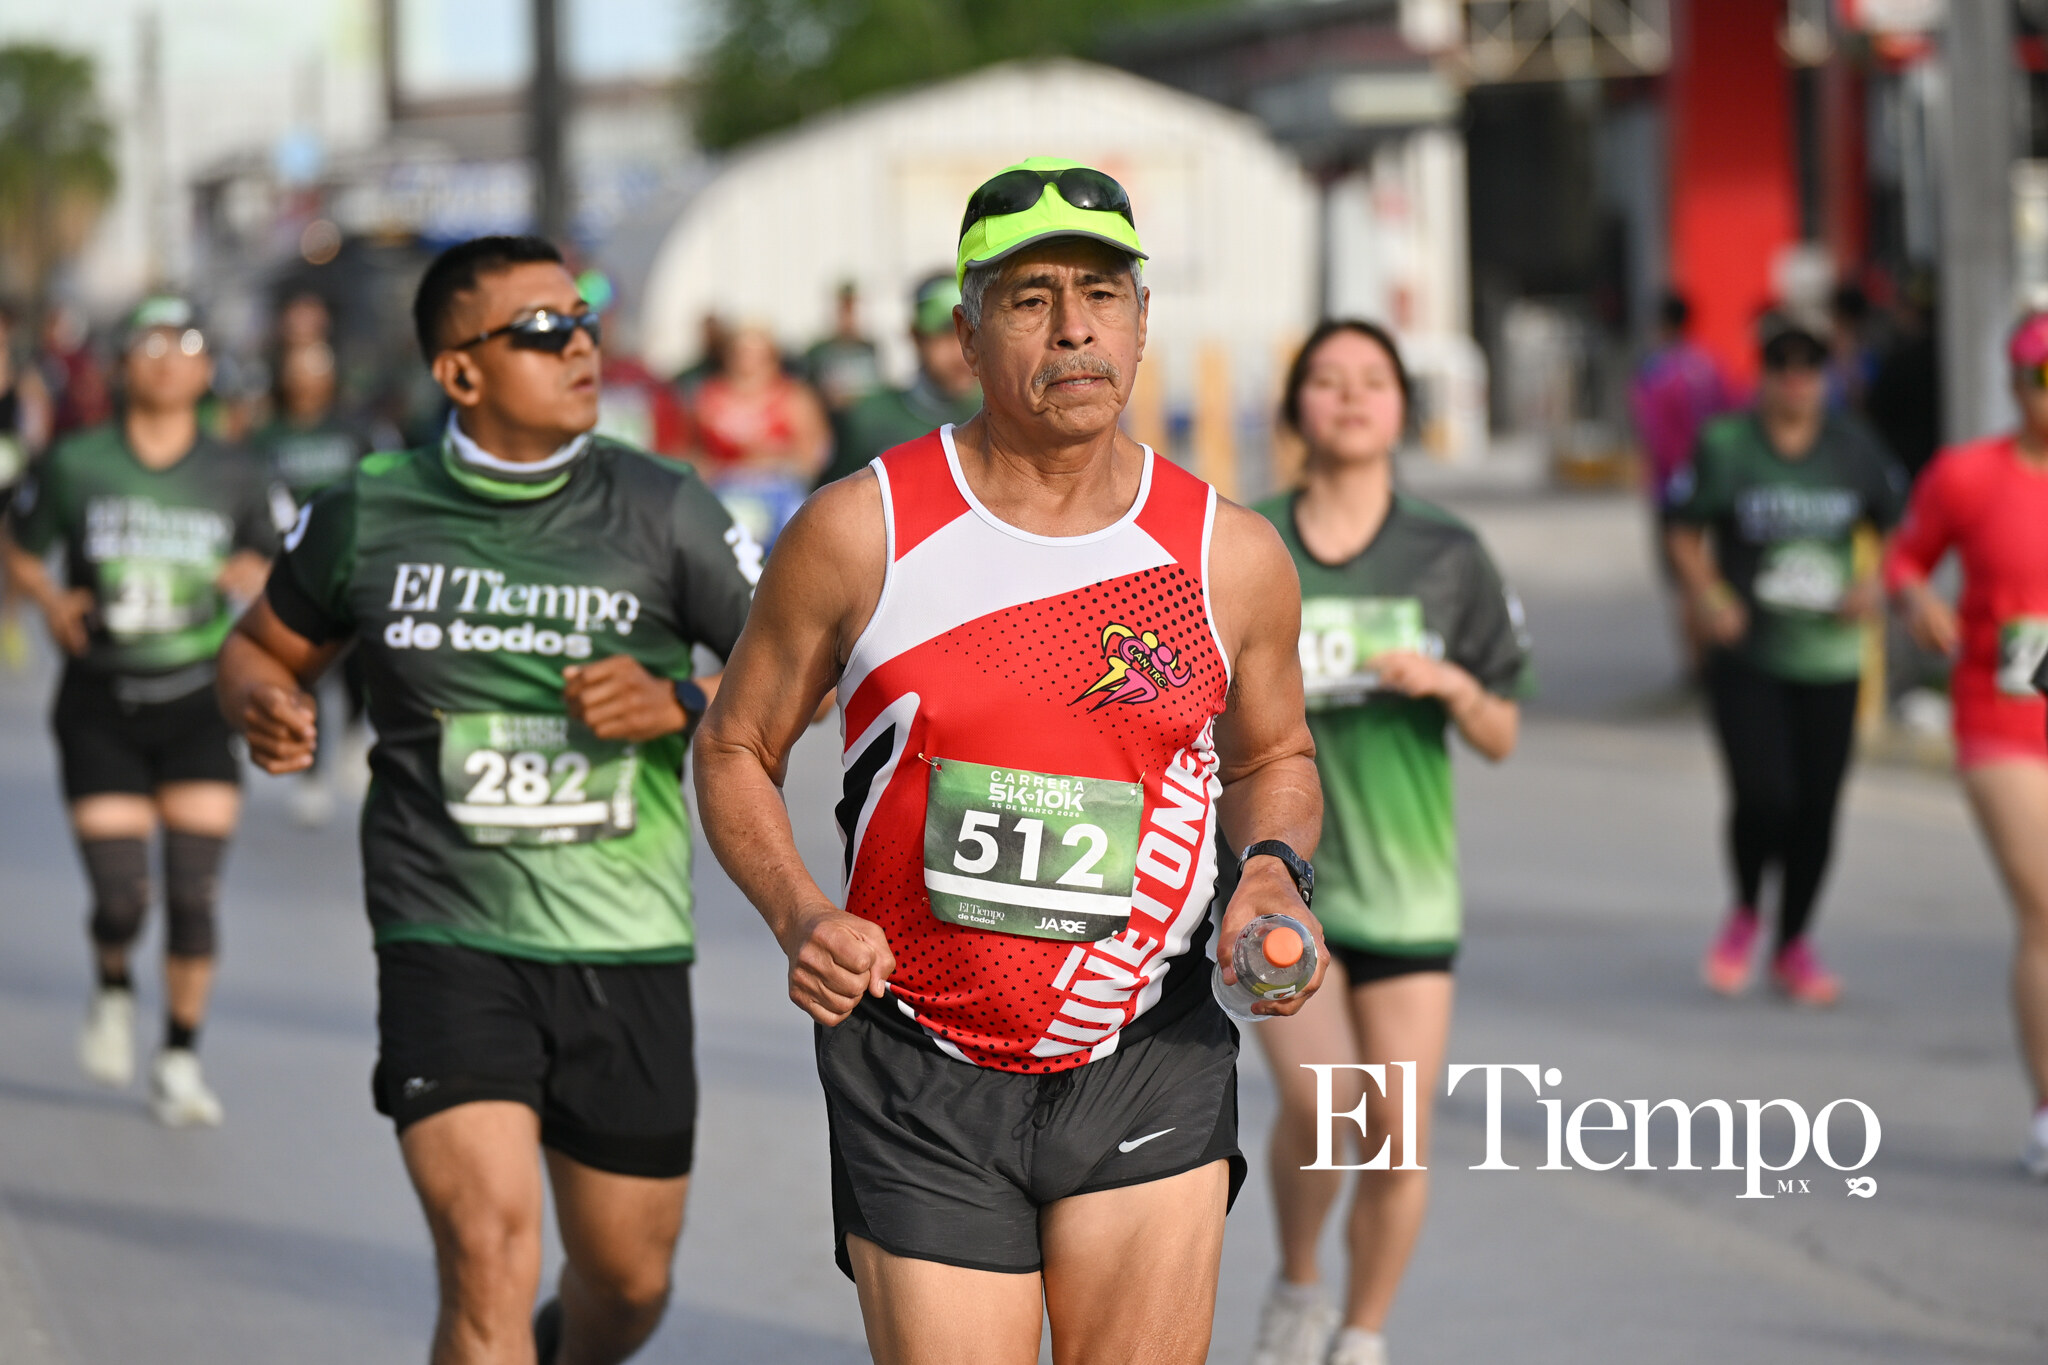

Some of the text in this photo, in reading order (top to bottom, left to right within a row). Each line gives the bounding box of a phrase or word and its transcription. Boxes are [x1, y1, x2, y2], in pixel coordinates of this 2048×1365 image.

[388, 562, 640, 634] El Tiempo
[384, 615, 443, 649] de
[448, 618, 592, 659] todos
[1148, 667, 1168, 689] TRC
[464, 748, 590, 806] 282
[990, 770, 1084, 793] CARRERA
[1021, 806, 1054, 815] MARZO
[1056, 810, 1080, 818] 2026
[953, 809, 1109, 889] 512
[957, 913, 996, 925] de todos
[958, 901, 1005, 921] El Tiempo
